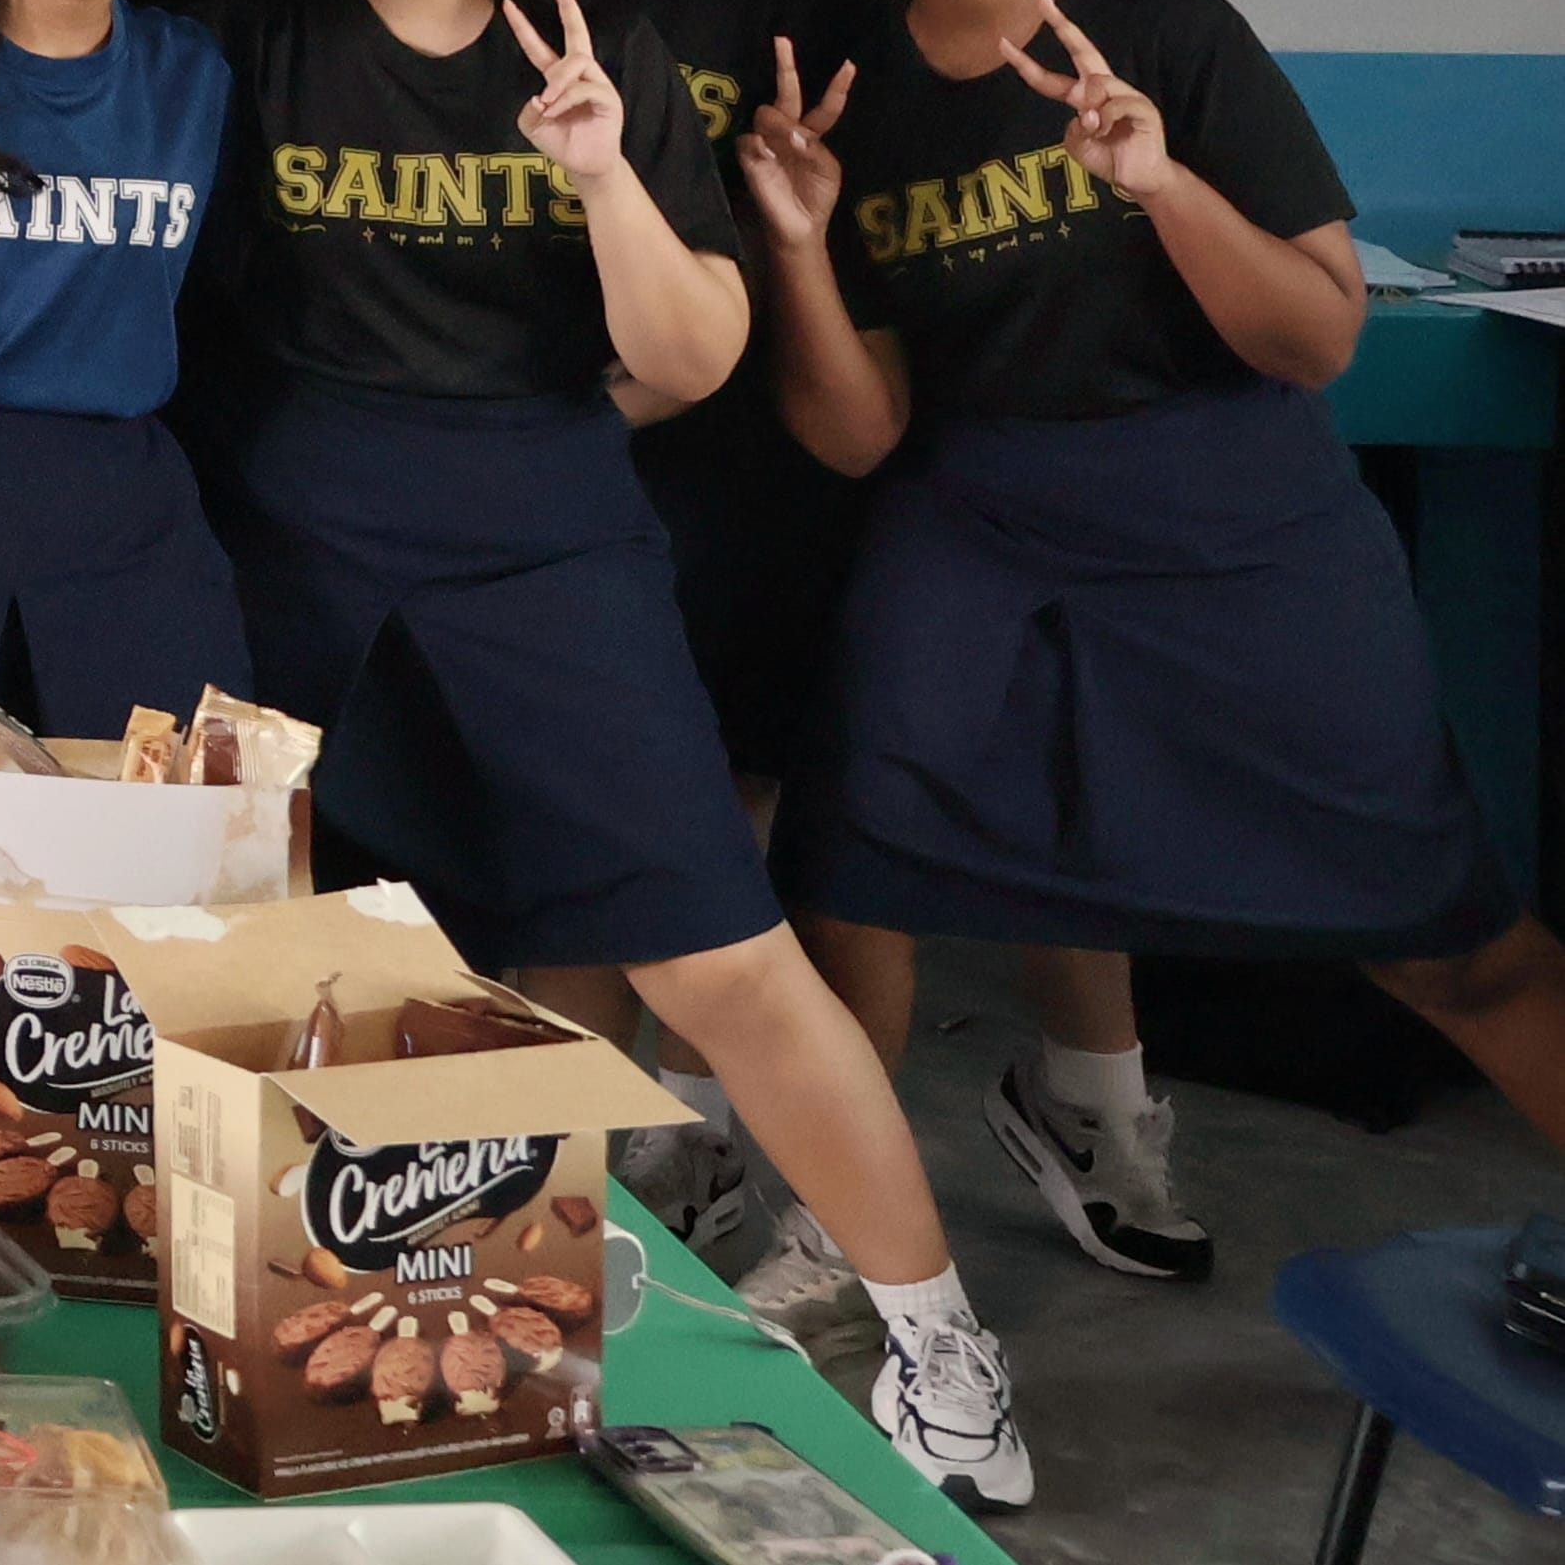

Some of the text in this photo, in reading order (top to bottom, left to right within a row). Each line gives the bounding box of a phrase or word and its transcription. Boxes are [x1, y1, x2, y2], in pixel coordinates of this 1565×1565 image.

[273, 142, 587, 227] SAINTS
[389, 231, 474, 246] up and on
[5, 1012, 154, 1084] Creme
[77, 1101, 152, 1135] MIN
[101, 1139, 150, 1154] STICKS
[396, 1244, 472, 1285] MINI
[407, 1285, 463, 1305] 6 STICKS
